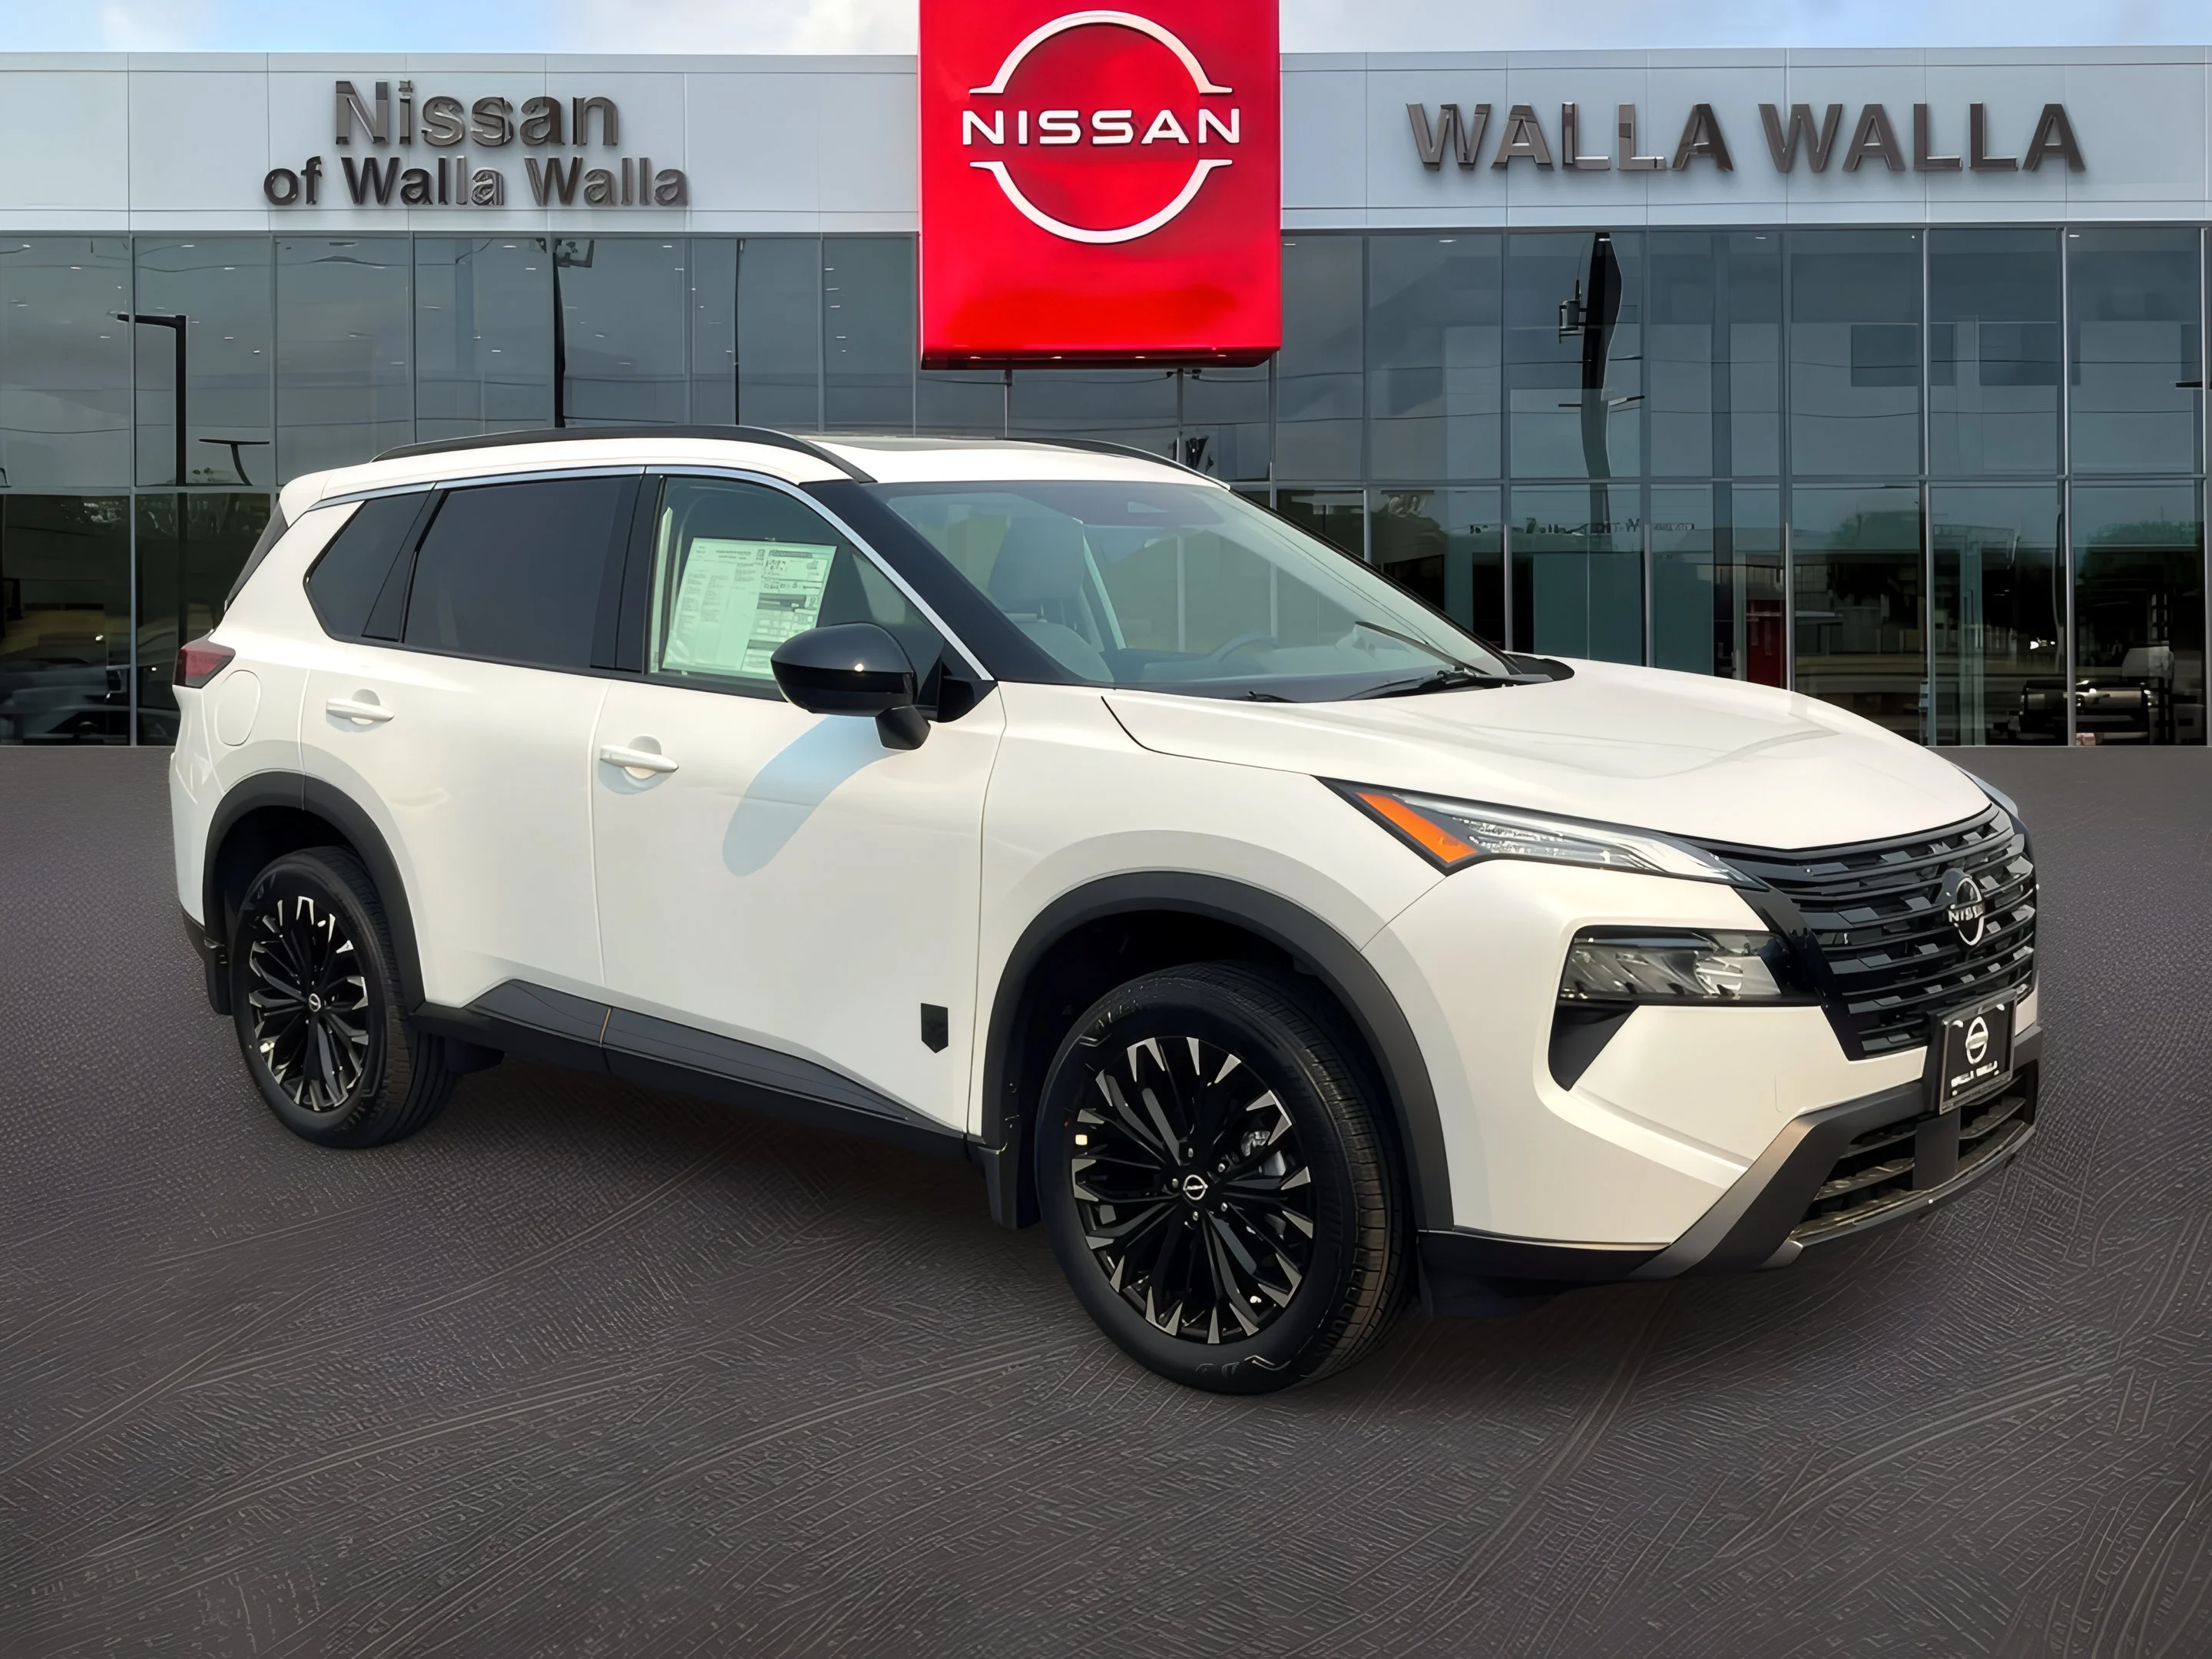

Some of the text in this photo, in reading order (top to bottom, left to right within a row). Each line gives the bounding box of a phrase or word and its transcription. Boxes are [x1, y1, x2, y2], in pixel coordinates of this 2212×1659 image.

[336, 80, 618, 147] Nissan
[962, 108, 1240, 145] NISSAN
[1406, 101, 2087, 173] WALLA WALLA
[264, 156, 689, 207] of Walla Walla
